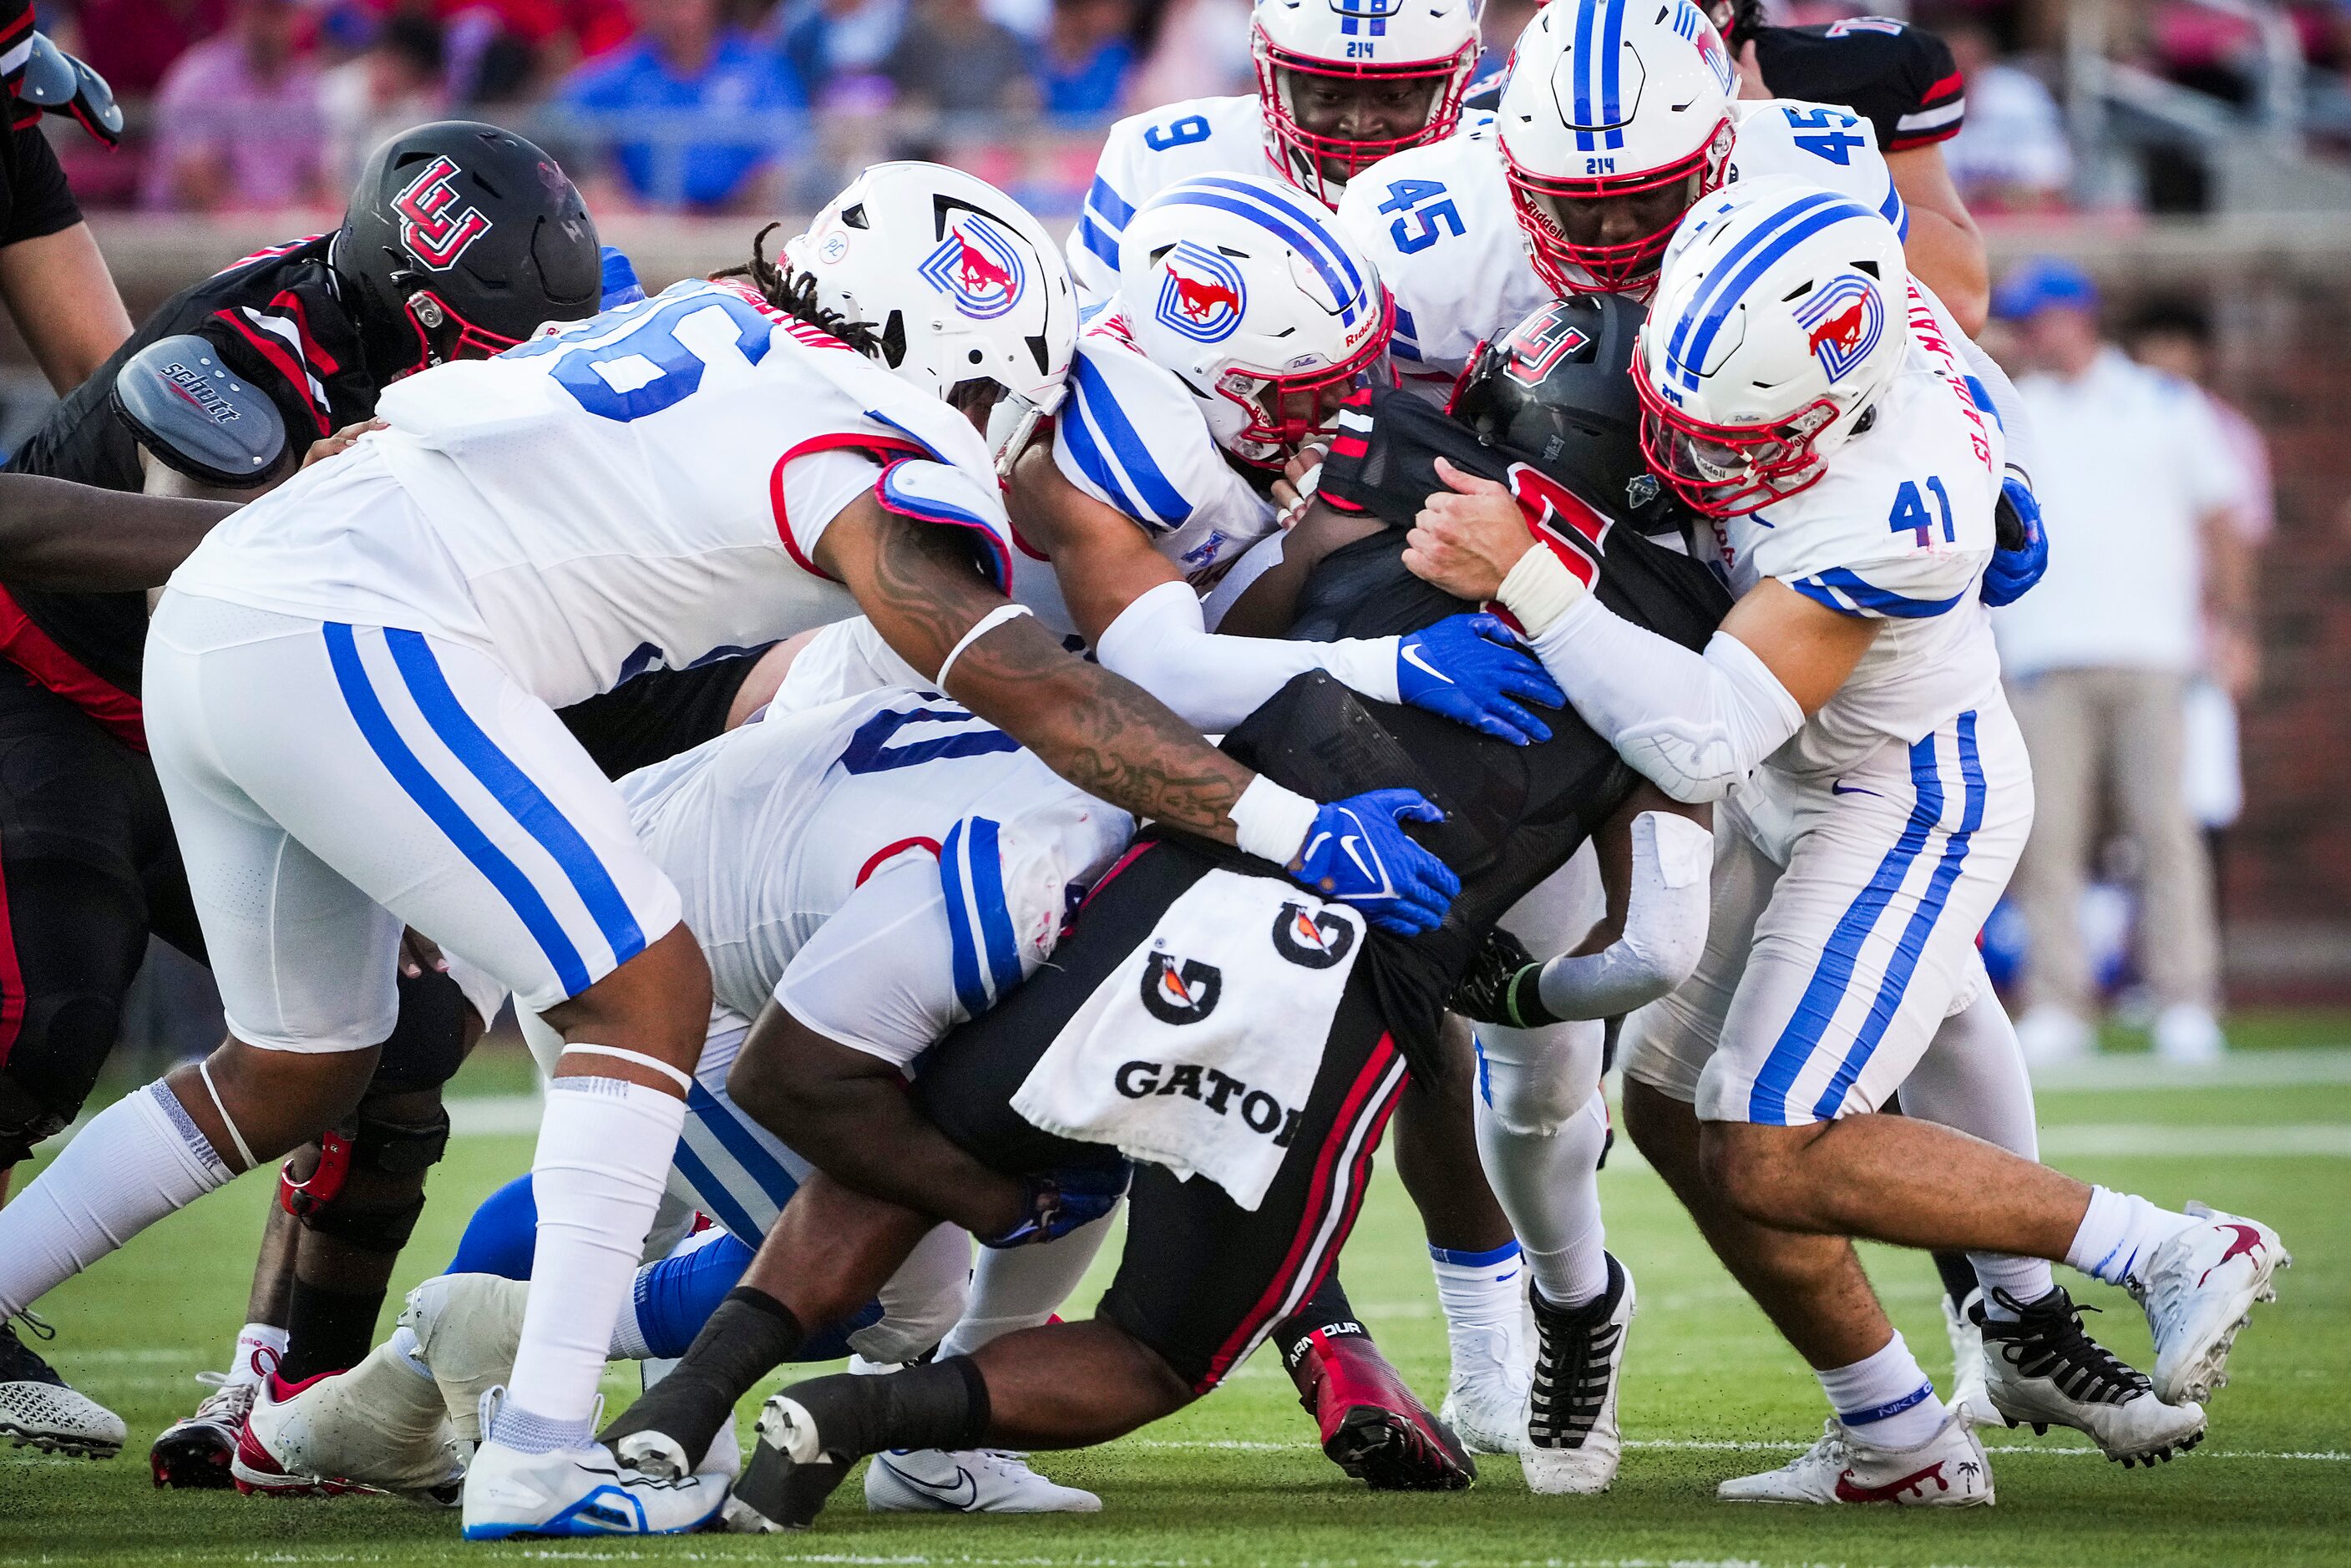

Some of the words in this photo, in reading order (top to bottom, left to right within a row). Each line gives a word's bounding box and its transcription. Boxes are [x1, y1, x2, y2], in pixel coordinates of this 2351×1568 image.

[1346, 41, 1374, 58] 214
[1143, 114, 1212, 152] 9
[1781, 107, 1865, 166] 45
[1586, 157, 1615, 175] 214
[390, 154, 494, 272] LU
[1376, 180, 1467, 255] 45
[1524, 199, 1566, 241] Riddell
[494, 277, 777, 423] 6
[1496, 300, 1591, 389] LU
[1662, 382, 1684, 408] 214
[1697, 455, 1725, 478] iddell
[1888, 475, 1956, 548] 41
[1877, 1391, 1921, 1418] NIKE
